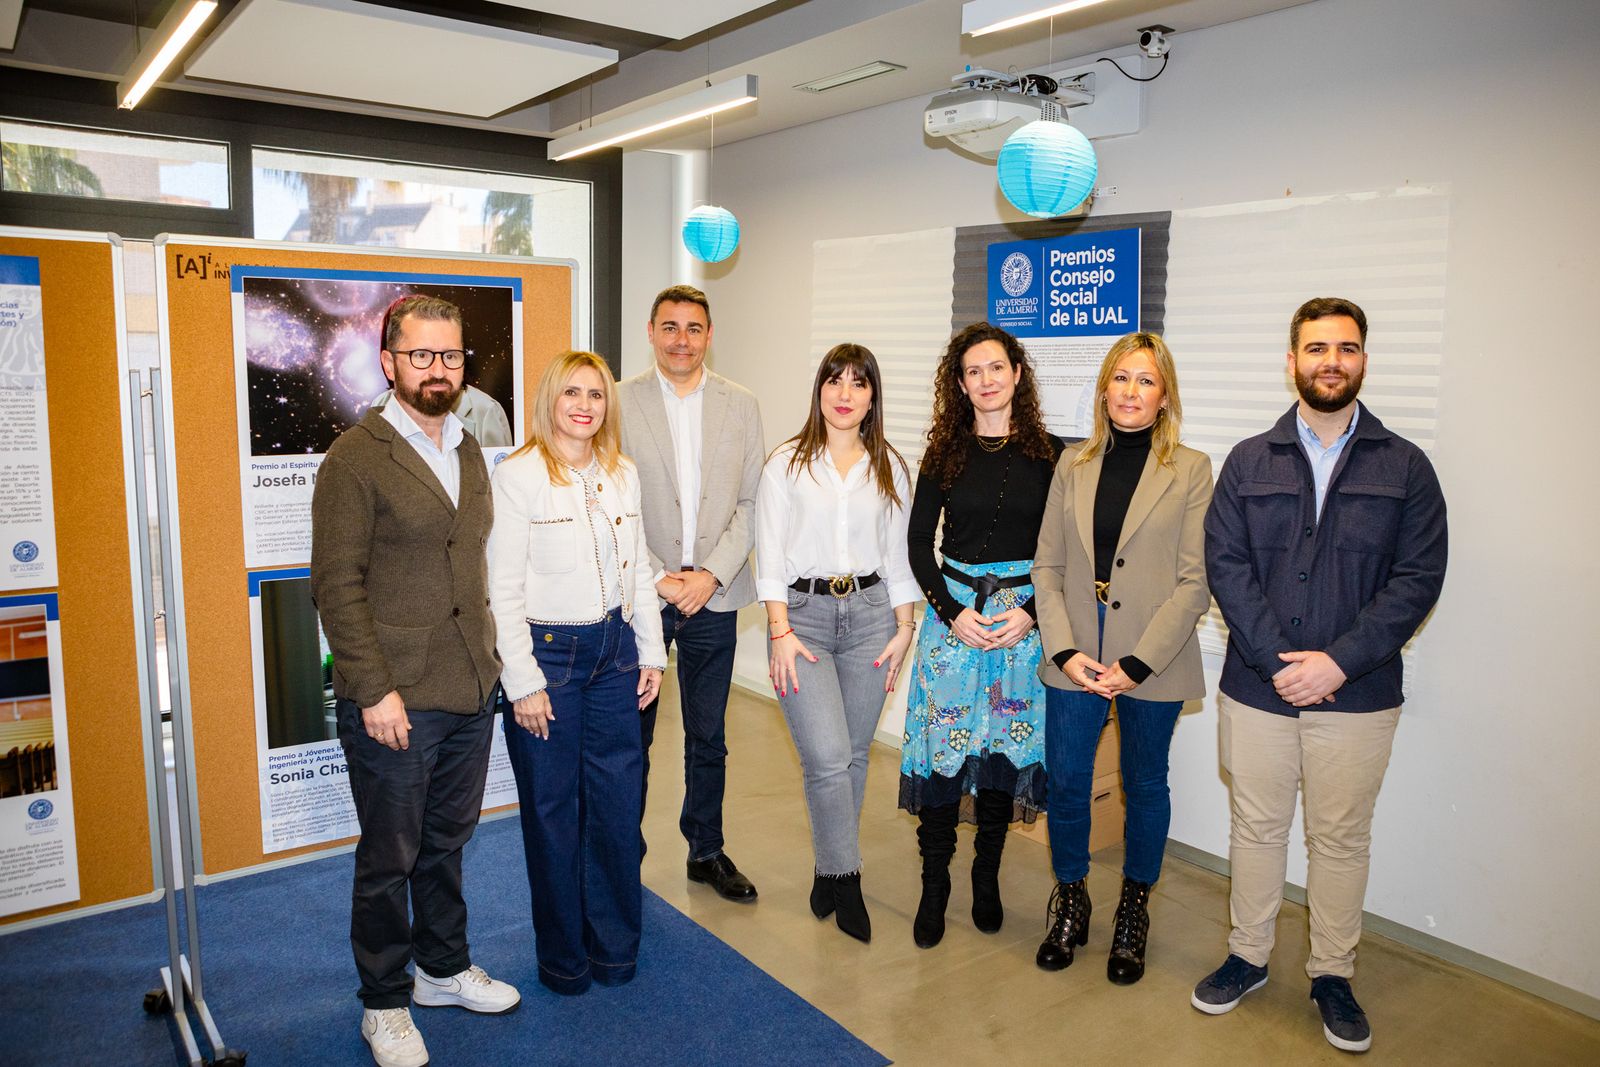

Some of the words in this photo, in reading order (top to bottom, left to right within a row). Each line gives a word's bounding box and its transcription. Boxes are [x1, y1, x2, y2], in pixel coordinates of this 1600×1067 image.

[1050, 246, 1116, 267] Premios
[1050, 266, 1116, 288] Consejo
[995, 297, 1038, 306] UNIVERSIDAD
[1050, 286, 1098, 306] Social
[996, 306, 1006, 315] DE
[1050, 308, 1070, 326] de
[1074, 308, 1088, 326] la
[1092, 306, 1128, 325] UAL
[251, 462, 279, 470] Premio
[290, 461, 318, 470] Espíritu
[252, 473, 306, 488] Josefa
[268, 752, 296, 762] Premio
[304, 747, 335, 757] Jóvenes
[269, 759, 307, 770] Ingeniería
[270, 768, 314, 784] Sonia
